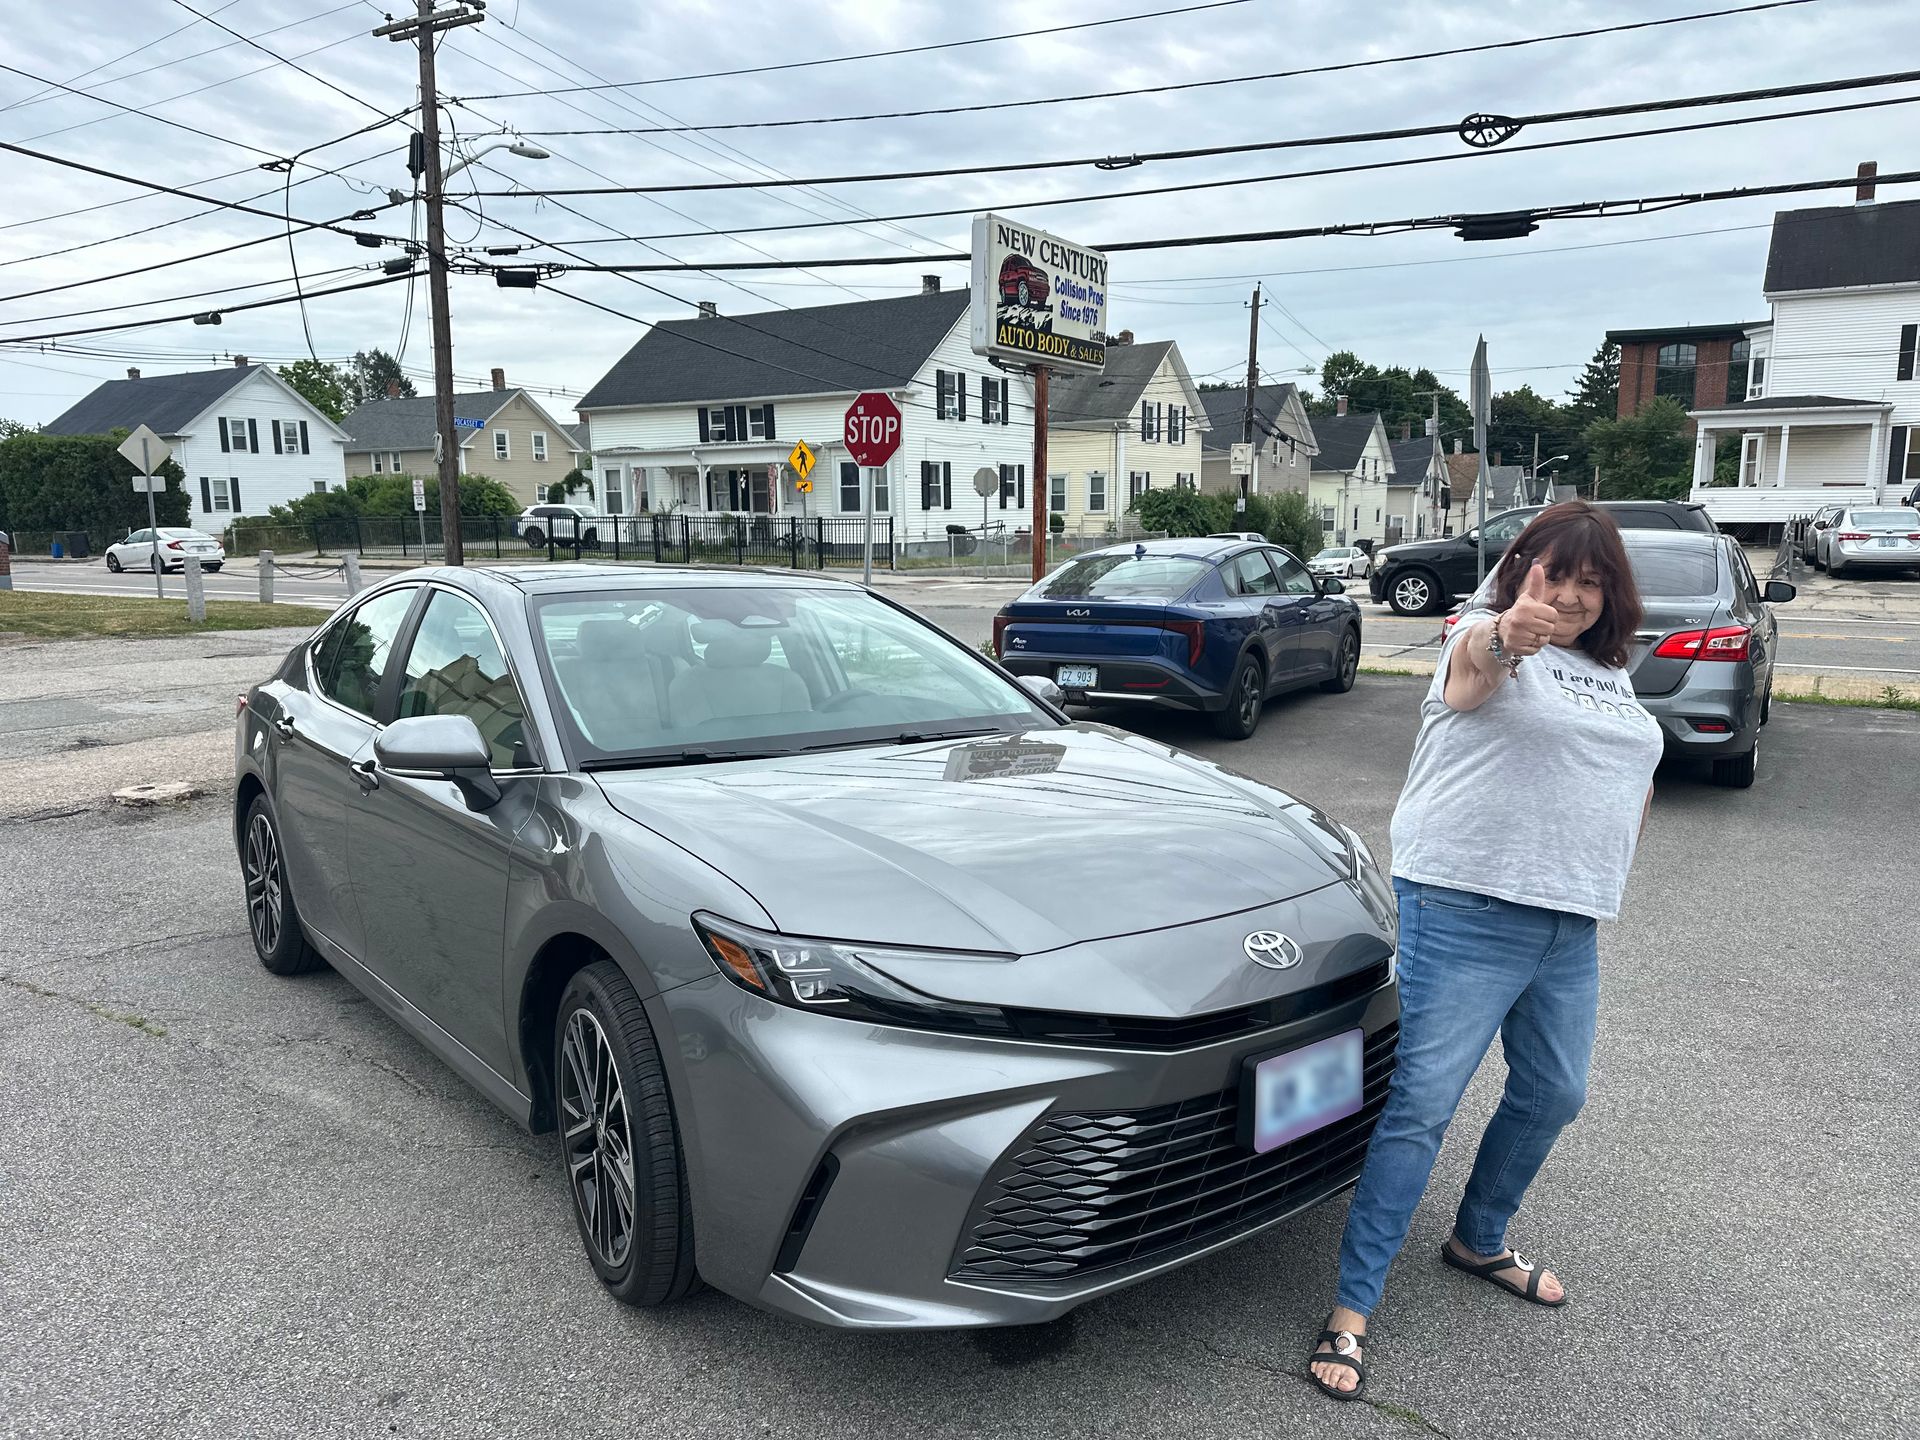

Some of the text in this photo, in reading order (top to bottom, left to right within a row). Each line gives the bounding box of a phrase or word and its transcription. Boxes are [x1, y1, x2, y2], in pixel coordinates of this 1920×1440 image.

[997, 224, 1108, 286] NEW CENTURY
[1055, 275, 1104, 306] Collision Pros
[1060, 300, 1098, 326] Since 1976
[998, 324, 1104, 363] AUTO BODY & SALES
[847, 415, 898, 444] STOP
[1061, 670, 1092, 683] CZ 903
